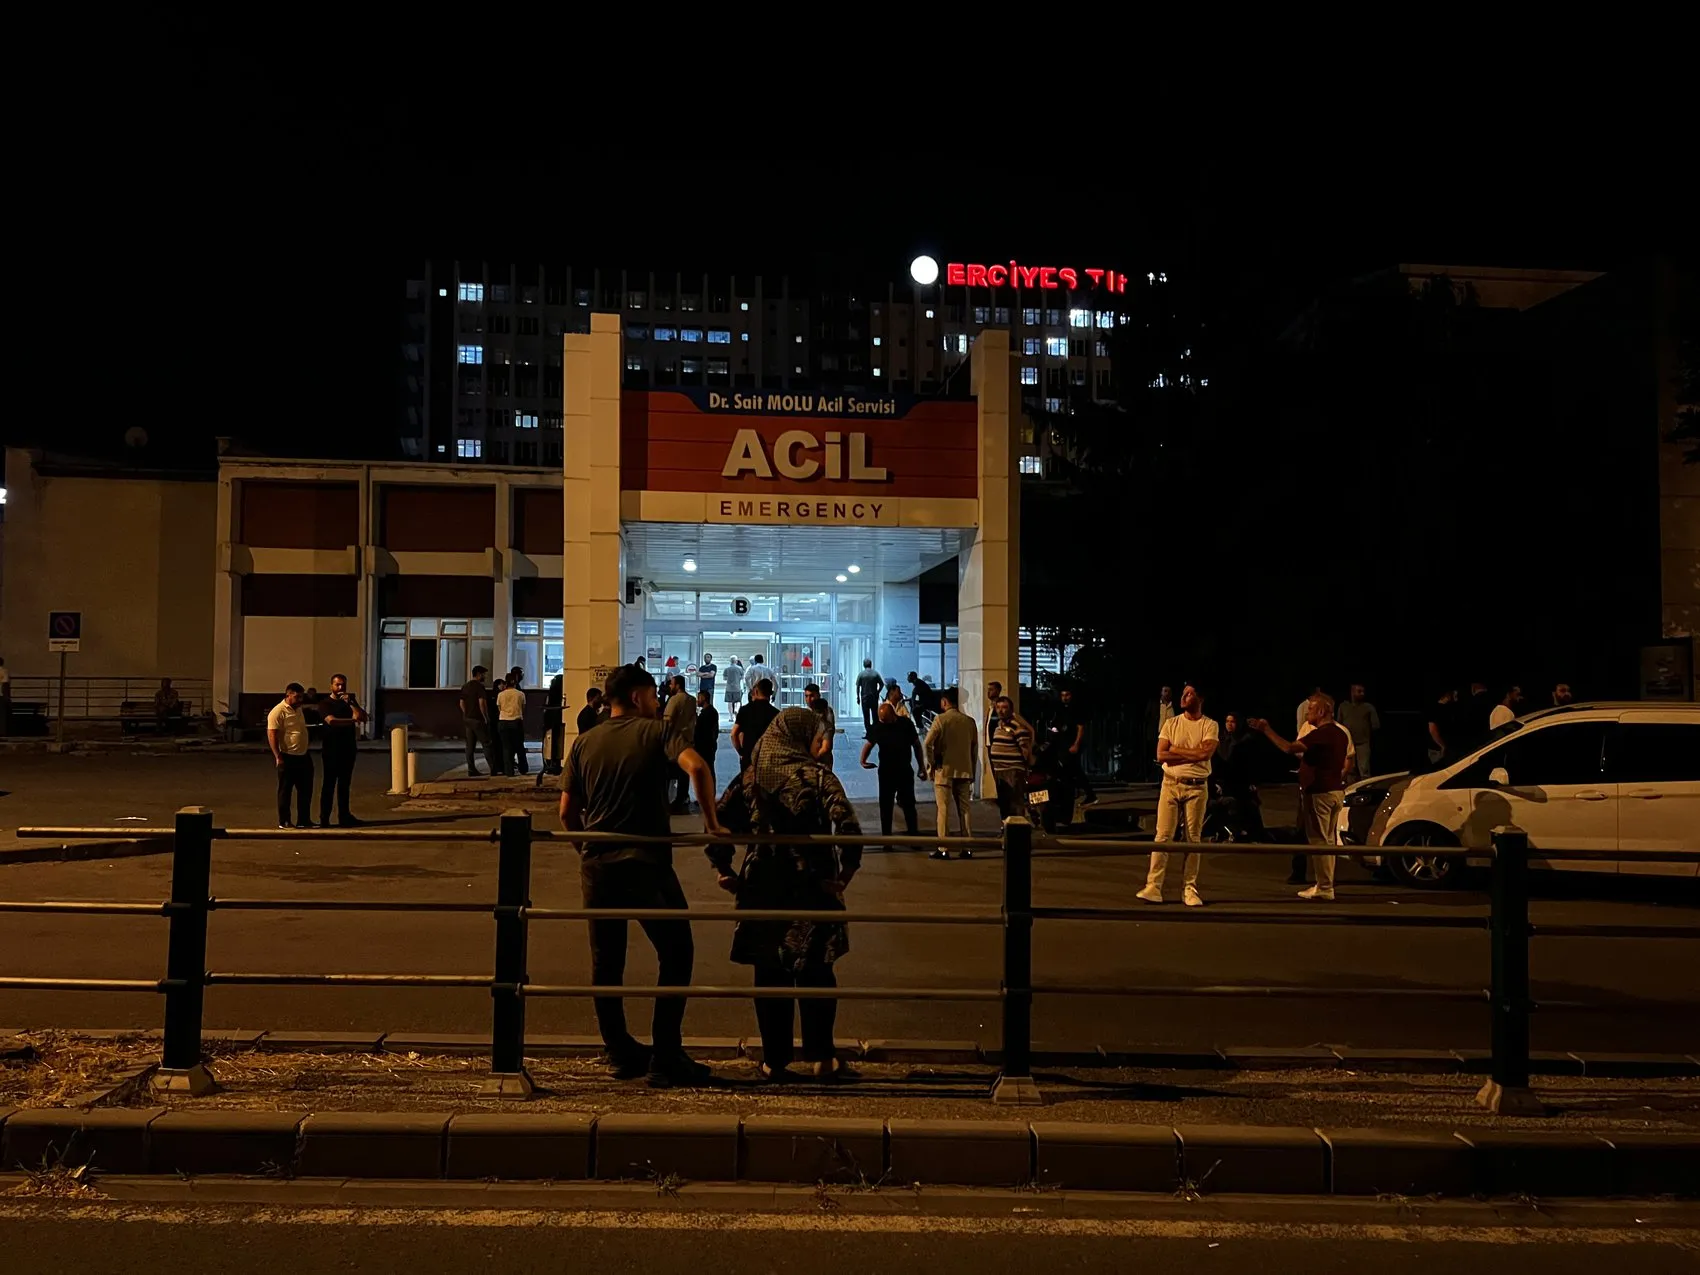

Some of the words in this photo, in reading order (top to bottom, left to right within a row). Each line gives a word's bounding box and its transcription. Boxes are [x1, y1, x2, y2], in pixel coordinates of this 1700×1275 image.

[709, 392, 729, 409] Dr.
[734, 393, 763, 410] Sait
[767, 395, 813, 411] MOLU
[817, 396, 843, 413] Acil
[848, 397, 895, 414] Servisi
[720, 501, 883, 519] EMERGENCY
[735, 599, 748, 614] B
